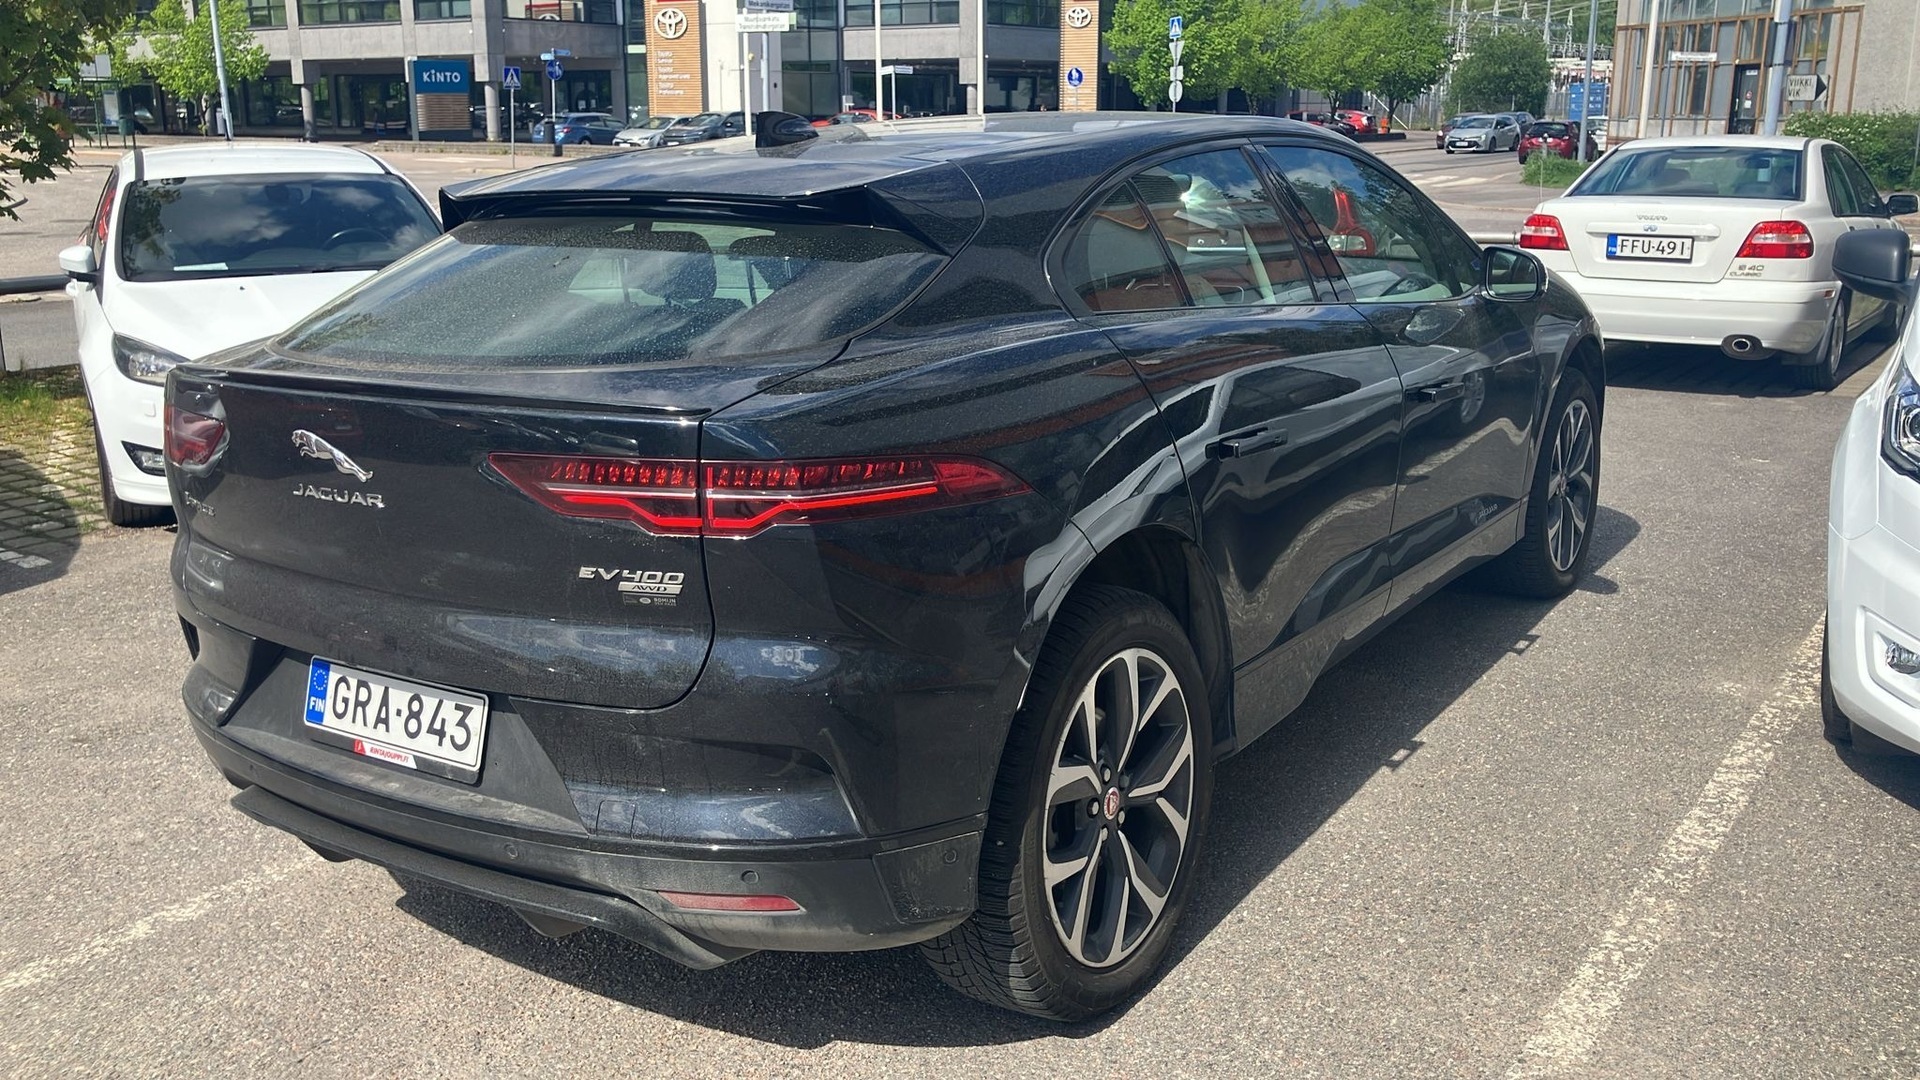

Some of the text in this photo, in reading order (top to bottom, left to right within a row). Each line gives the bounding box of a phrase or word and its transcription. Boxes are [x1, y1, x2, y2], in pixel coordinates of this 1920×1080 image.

[1619, 239, 1686, 256] FFU-491
[293, 483, 385, 508] JAGUAR
[578, 566, 685, 585] EV400
[632, 584, 668, 592] AWD
[309, 697, 325, 713] FIN
[332, 675, 474, 752] GRA-843
